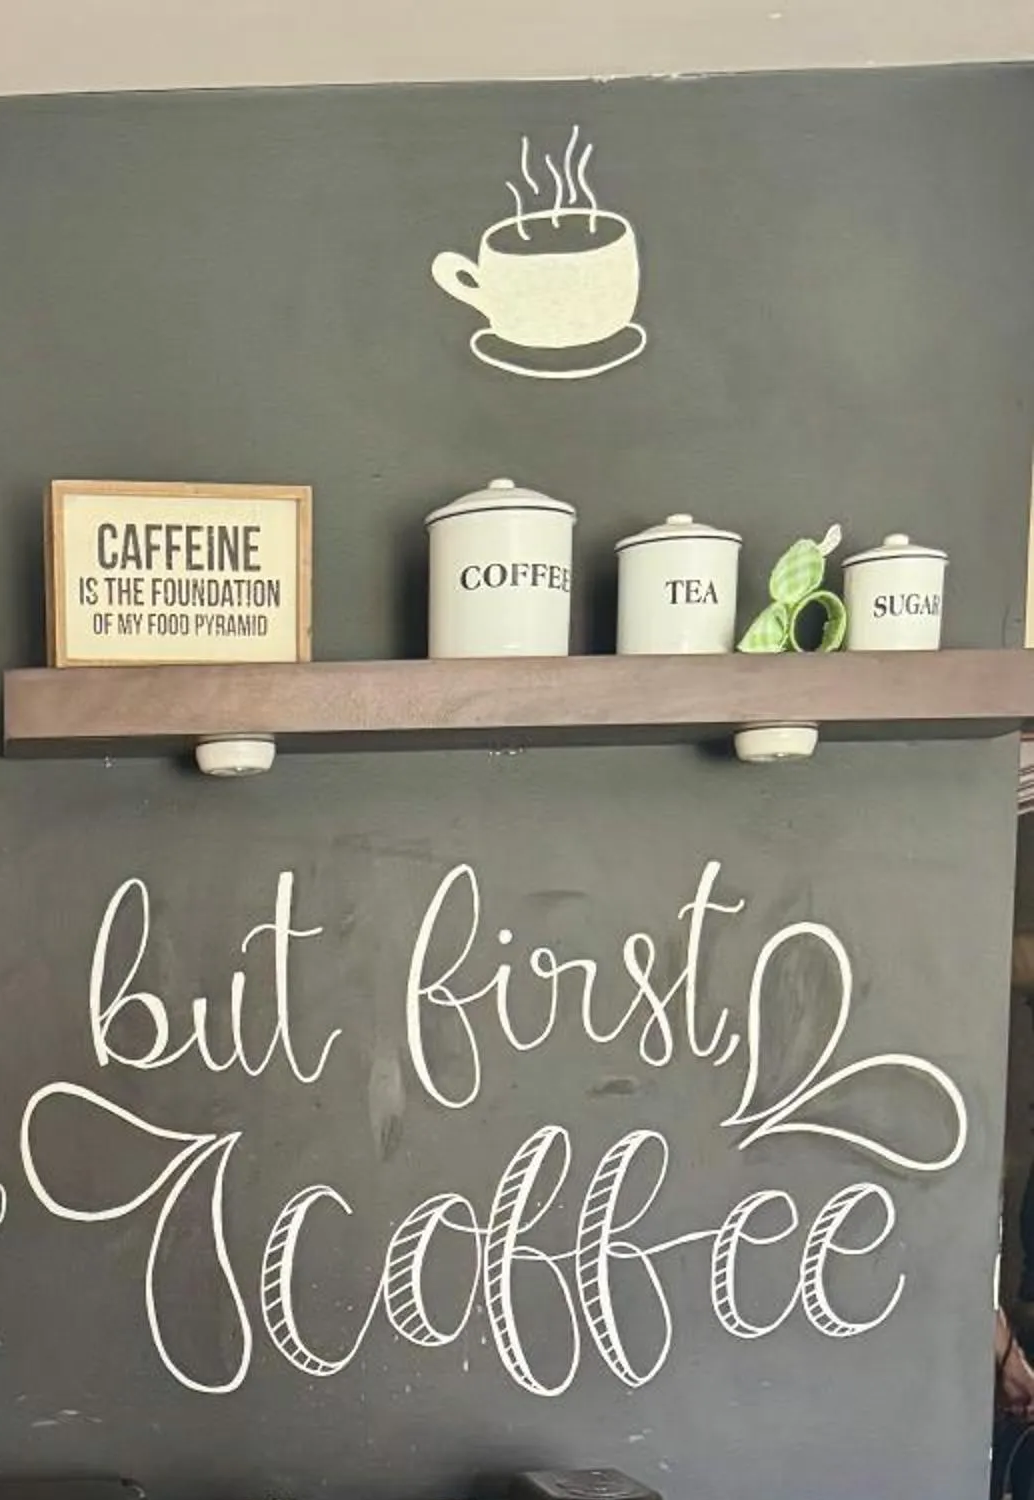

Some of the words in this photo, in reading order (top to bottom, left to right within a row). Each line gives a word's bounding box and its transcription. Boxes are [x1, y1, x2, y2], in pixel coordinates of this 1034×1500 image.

[97, 522, 262, 572] CAFFEINE
[79, 576, 99, 606] IS
[104, 577, 145, 606] THE
[151, 577, 281, 608] FOUNDATION
[460, 563, 570, 592] COFFEE
[665, 579, 719, 605] TEA
[873, 593, 941, 618] SUGAR
[93, 612, 113, 635] OF
[117, 612, 143, 636] MY
[148, 613, 189, 636] FOOD
[195, 613, 268, 637] PYRAMID
[89, 871, 342, 1082] but
[261, 1125, 905, 1396] coffee
